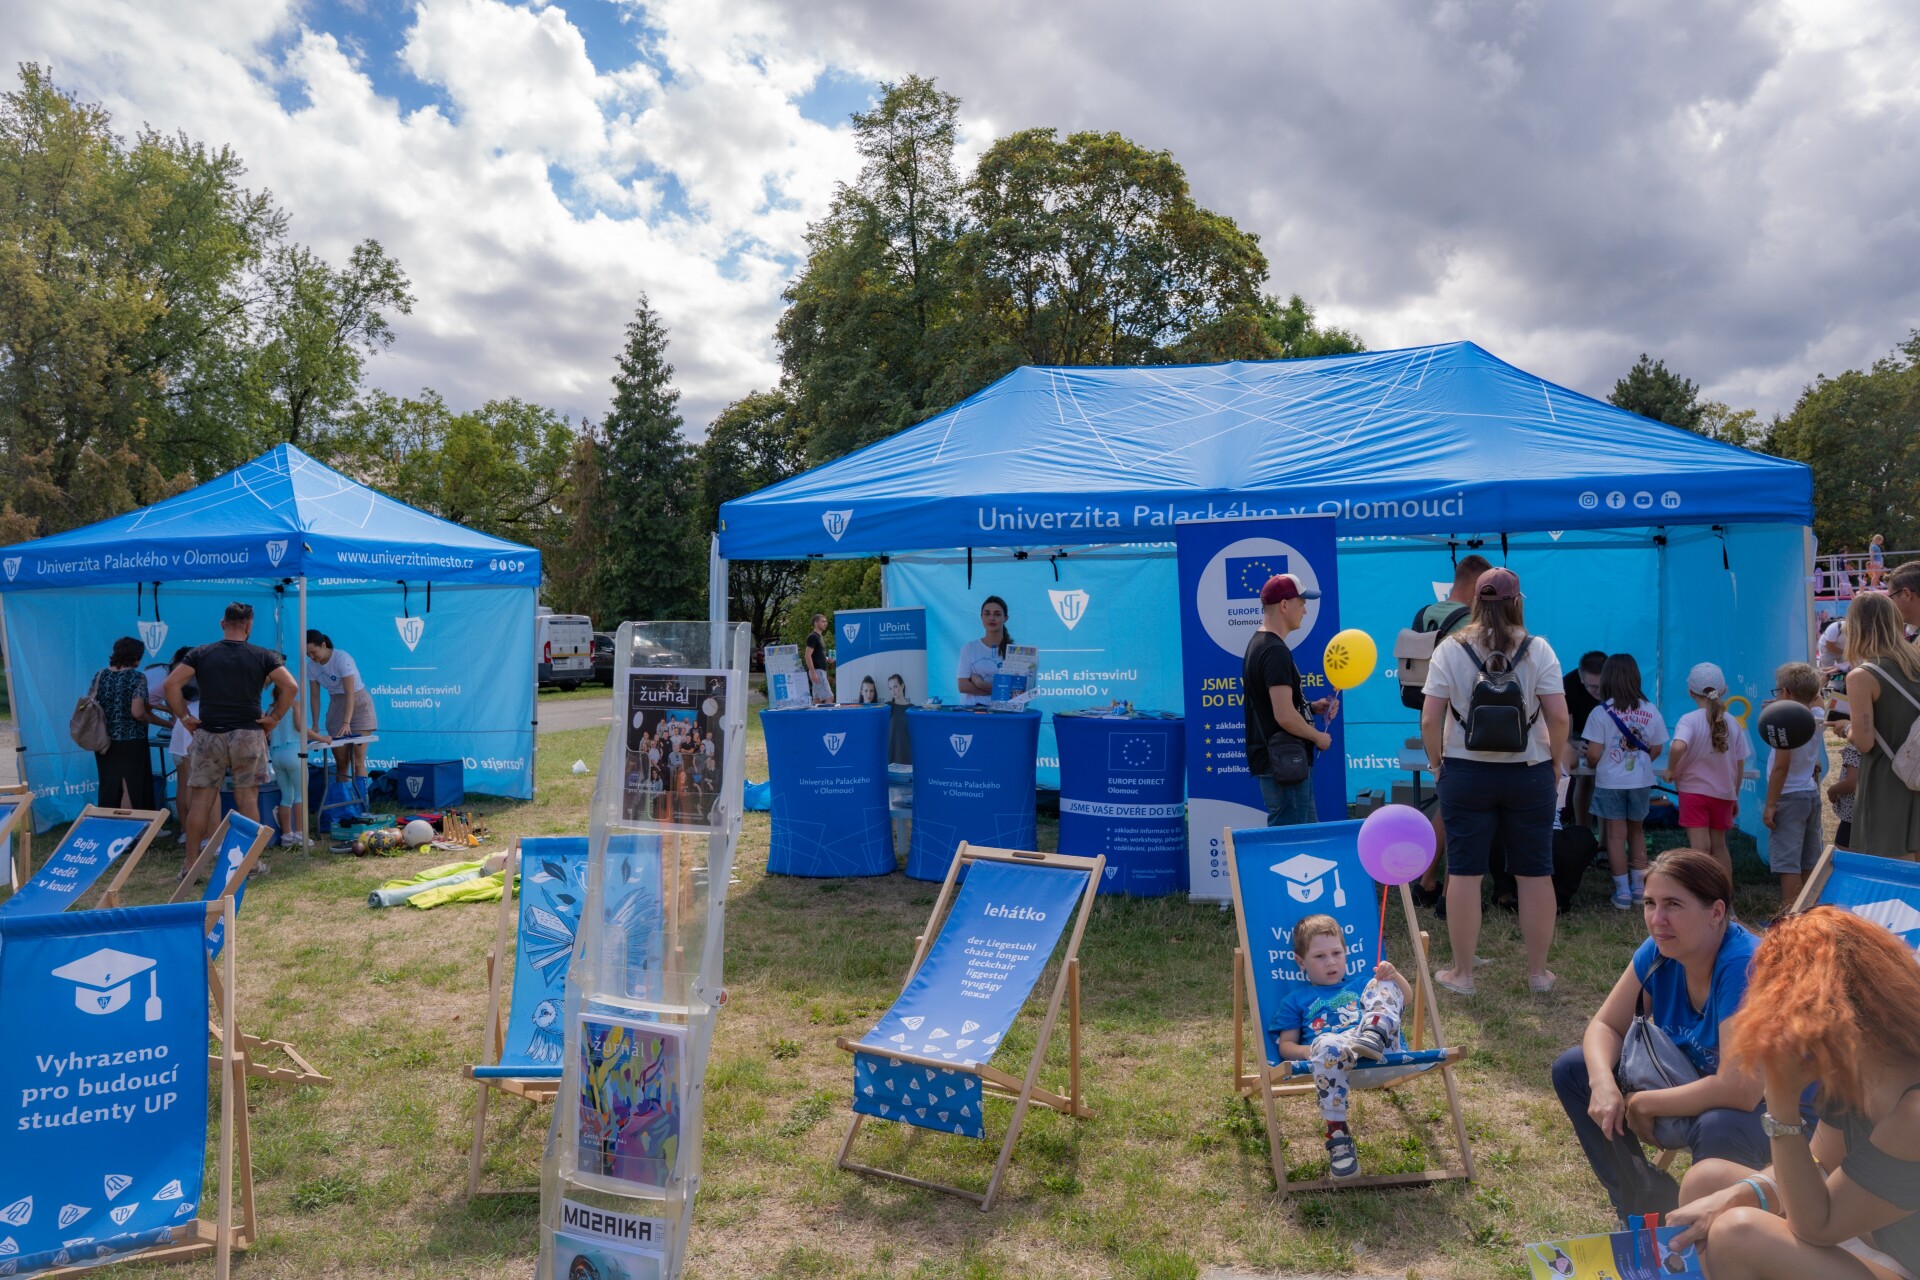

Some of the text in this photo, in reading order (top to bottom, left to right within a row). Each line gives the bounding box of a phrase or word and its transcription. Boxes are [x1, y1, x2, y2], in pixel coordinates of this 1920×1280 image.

[978, 506, 1121, 531] Univerzita
[1317, 491, 1464, 520] Olomouci
[37, 548, 249, 575] Univerzita Palackého v Olomouci
[337, 550, 474, 570] www.univerzitnimesto.cz
[1228, 608, 1260, 616] EUROPE
[879, 622, 911, 632] UPoint
[1202, 678, 1237, 690] JSME
[1300, 672, 1325, 688] EŘE
[640, 686, 690, 704] žurnál
[1202, 694, 1224, 707] DO
[1216, 722, 1246, 730] základn
[1218, 765, 1250, 774] publikac
[836, 776, 871, 785] Palackého
[928, 778, 1000, 789] Univerzita Palackého
[949, 789, 984, 798] Olomouci
[1108, 787, 1139, 795] Olomouc
[1070, 802, 1090, 813] JSME
[1092, 803, 1113, 815] VAŠE
[1116, 804, 1146, 816] DVEŘE
[1150, 806, 1164, 815] DO
[73, 838, 100, 851] Bejby
[63, 853, 97, 865] nebude
[50, 866, 79, 879] sedět
[39, 880, 77, 893] v koutě
[984, 903, 1046, 921] lehátko
[967, 936, 1037, 951] der Liegestuhl
[964, 947, 1029, 962] chaise longue
[1268, 949, 1295, 963] pro
[968, 958, 1016, 971] deckchair
[966, 969, 1009, 980] liggestol
[961, 979, 1002, 991] nyugágy
[36, 1045, 169, 1077] Vyhrazeno
[22, 1064, 180, 1107] pro budoucí
[17, 1092, 178, 1131] studenty UP
[564, 1204, 652, 1242] MOZAIKA
